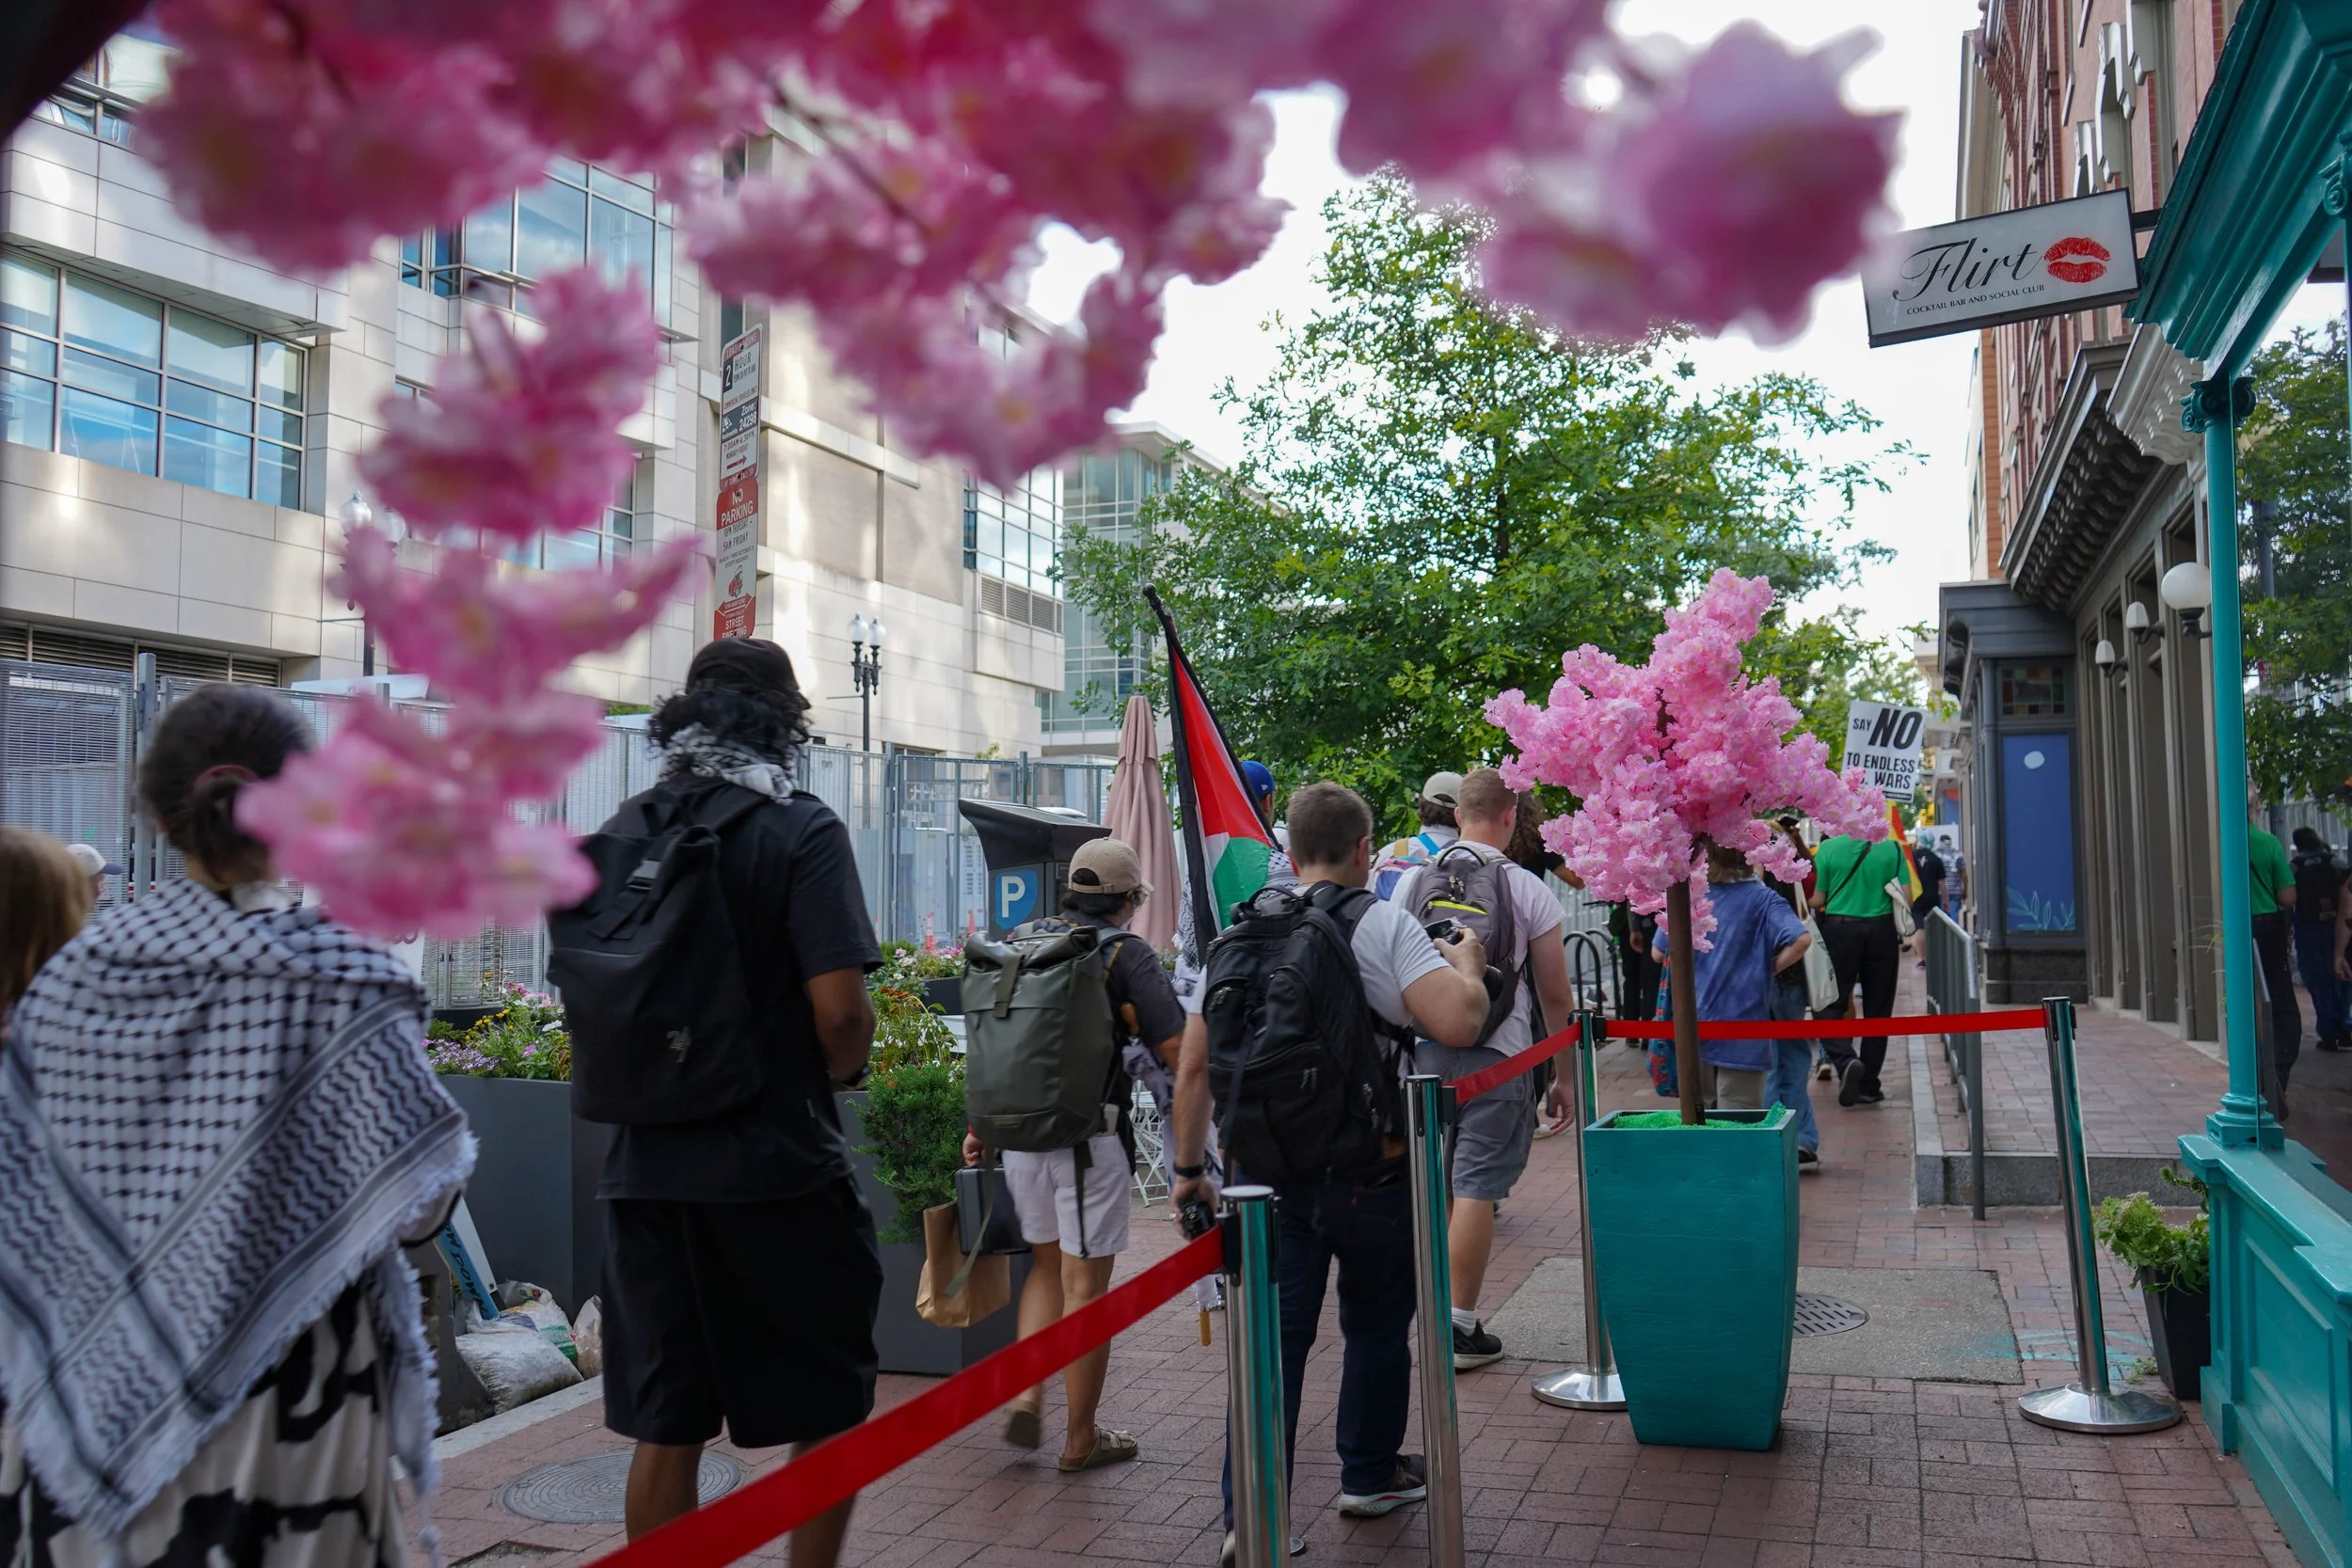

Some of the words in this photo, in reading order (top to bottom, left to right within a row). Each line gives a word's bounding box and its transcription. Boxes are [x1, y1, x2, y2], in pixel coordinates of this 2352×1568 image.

[1892, 237, 2042, 301] Flirt
[1906, 303, 1948, 315] COCKTAIL
[1949, 298, 1966, 309] BAR
[1968, 294, 1988, 304] AND
[1989, 288, 2022, 300] SOCIAL
[2023, 284, 2045, 294] CLUB
[725, 364, 732, 387] 2
[735, 352, 752, 372] HOUR
[741, 402, 756, 416] Zone:
[739, 411, 757, 432] 24298
[732, 488, 743, 506] NO
[721, 499, 754, 528] PARKING
[733, 531, 750, 546] FRIDAY
[725, 615, 744, 630] STREET
[1852, 718, 1872, 731] SAY
[1867, 707, 1923, 750] NO
[1847, 752, 1860, 767] TO
[1864, 754, 1915, 773] ENDLESS
[1874, 771, 1912, 789] WARS
[1001, 876, 1025, 918] P
